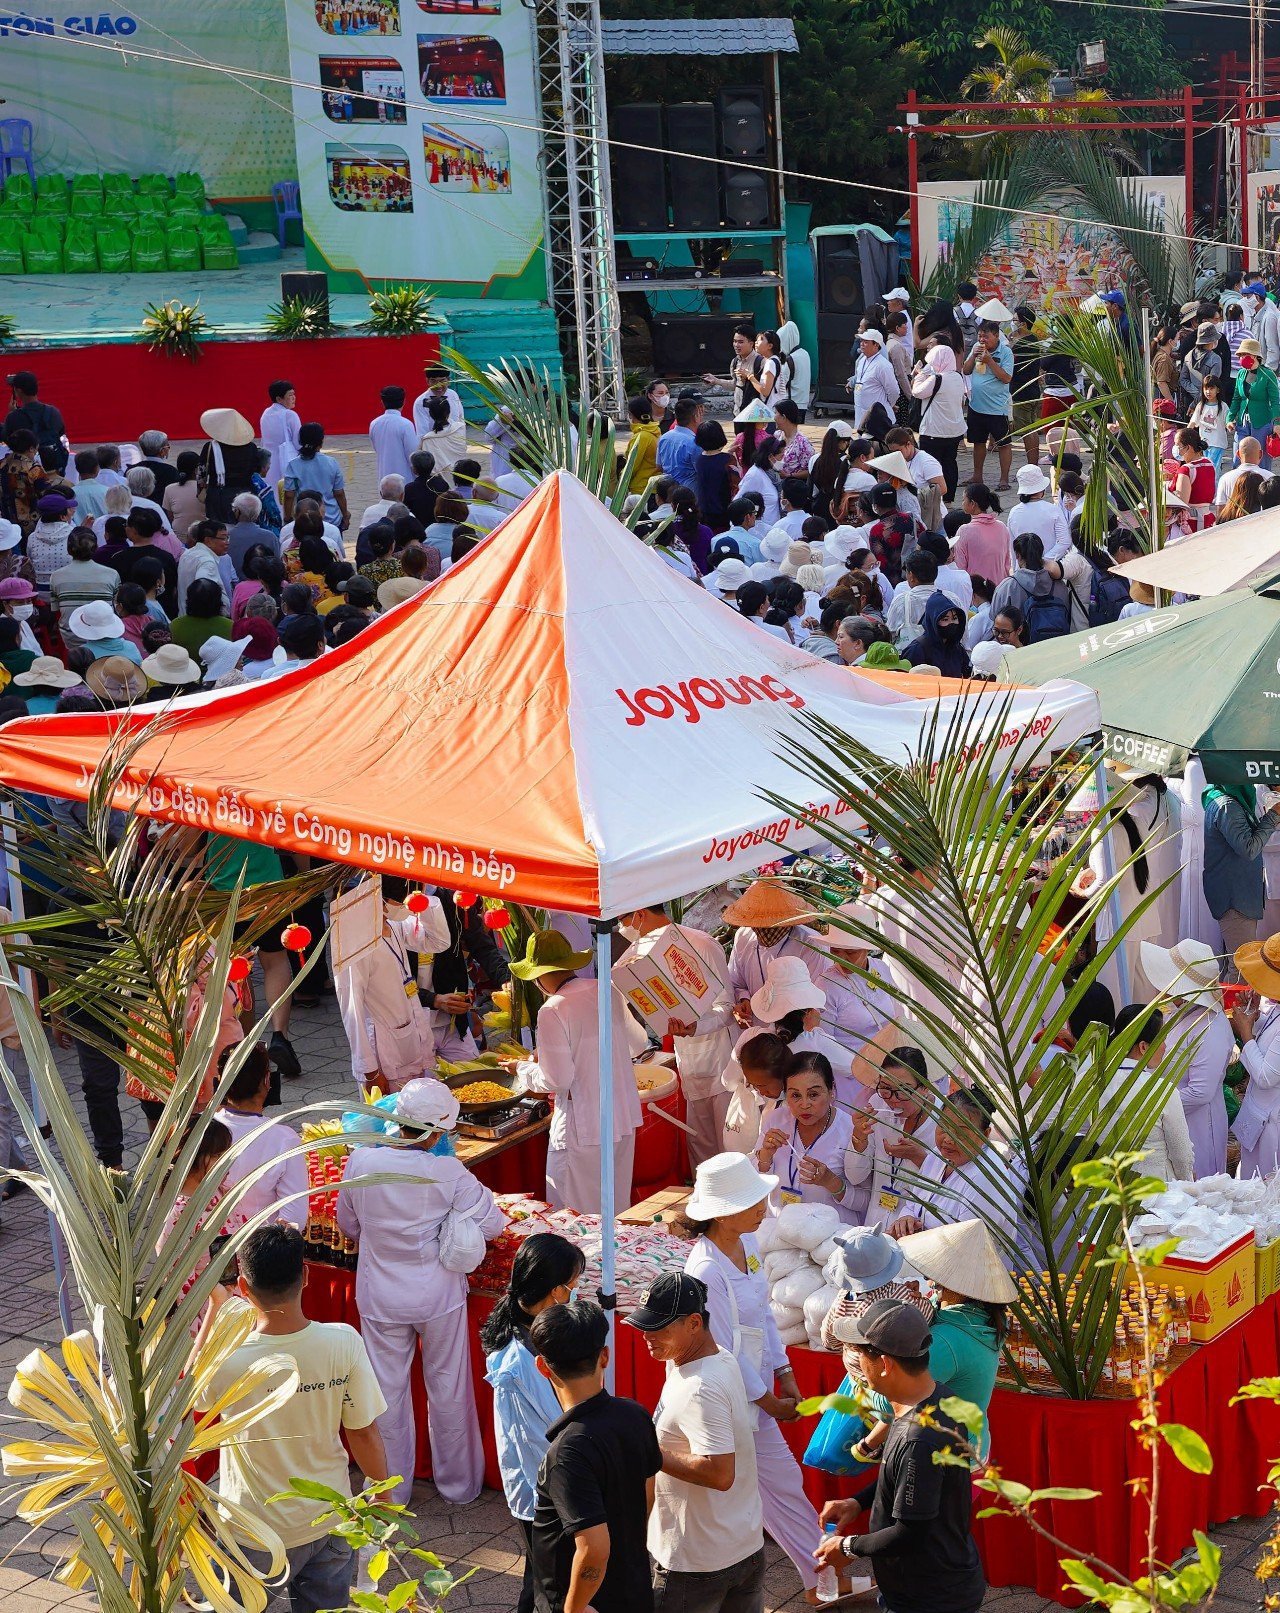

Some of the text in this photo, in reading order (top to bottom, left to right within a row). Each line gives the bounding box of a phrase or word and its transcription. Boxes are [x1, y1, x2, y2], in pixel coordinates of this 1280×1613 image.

[64, 13, 137, 36] GIÁO
[615, 674, 806, 726] Joyoung
[1113, 734, 1169, 766] COFFEE
[1245, 761, 1280, 779] ĐT:
[172, 783, 209, 817] dẫn
[216, 792, 254, 827] đầu
[260, 801, 287, 834] về
[294, 812, 351, 856] Công
[359, 832, 415, 869] nghệ
[422, 842, 465, 874] nhà
[471, 848, 516, 890] bếp
[703, 817, 790, 864] Joyoung
[905, 1483, 915, 1506] PRO
